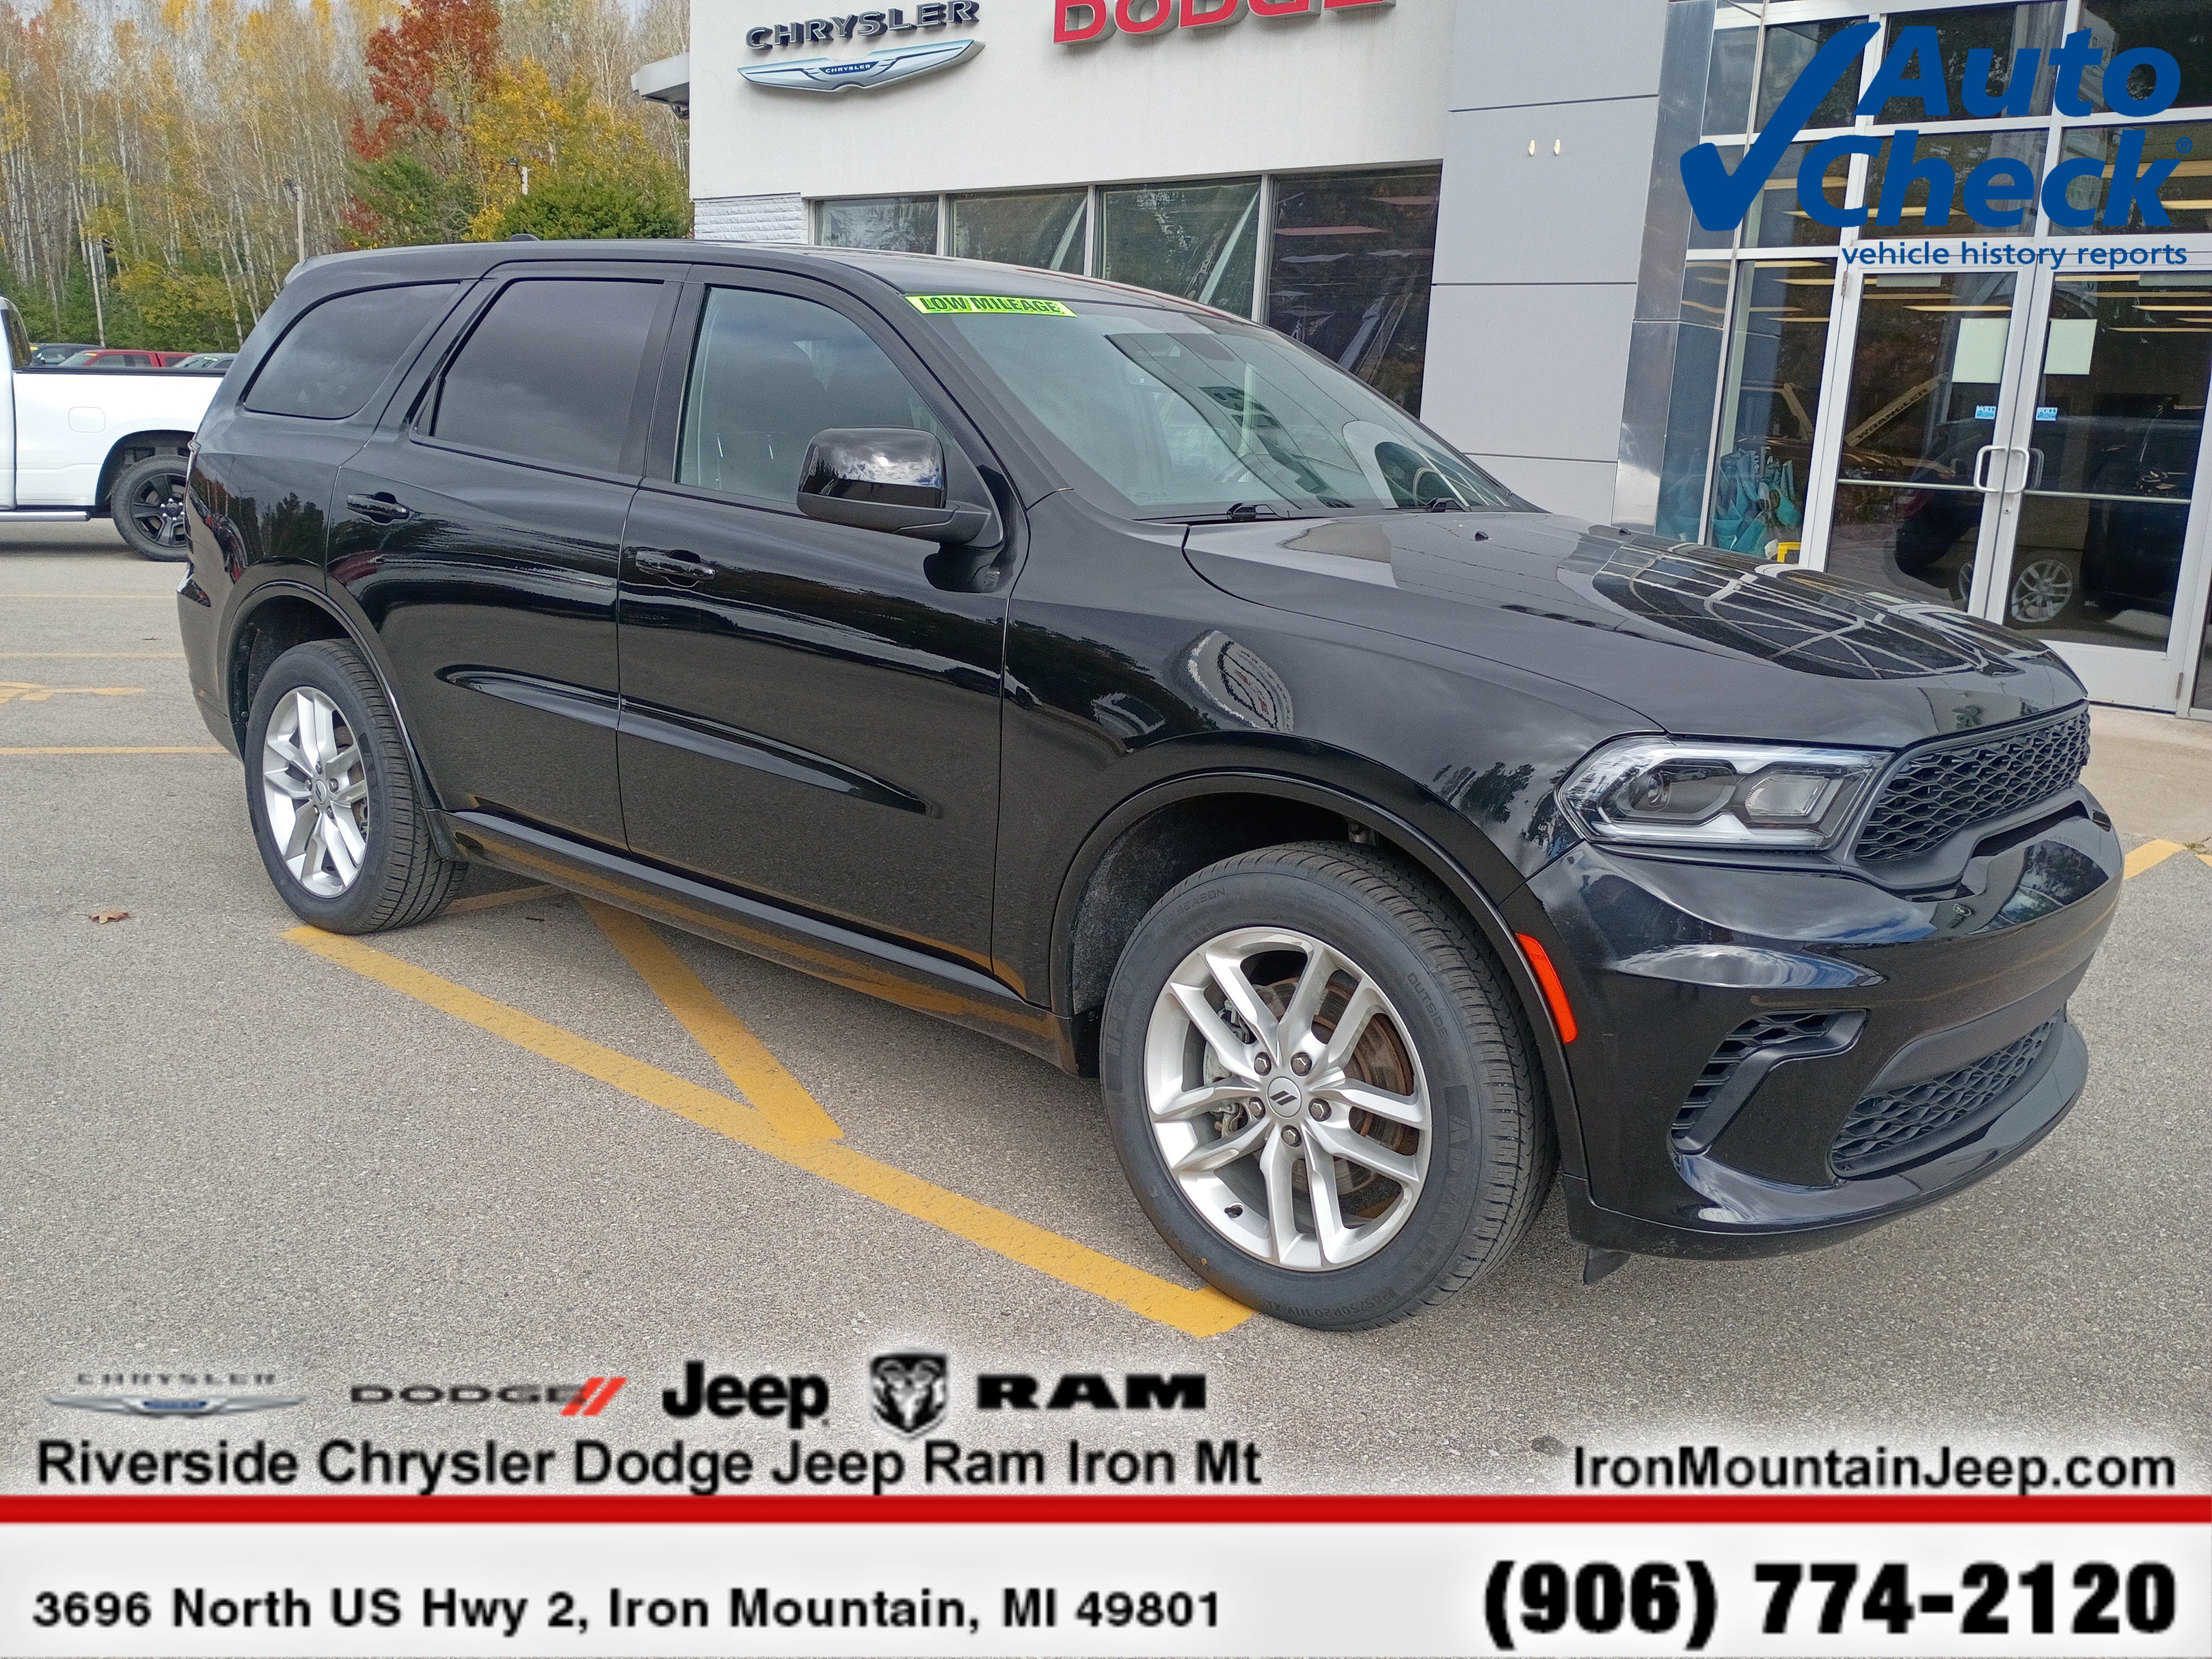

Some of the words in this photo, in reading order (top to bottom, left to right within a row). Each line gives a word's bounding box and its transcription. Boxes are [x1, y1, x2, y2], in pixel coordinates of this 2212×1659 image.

[745, 0, 978, 49] CHRYSLER
[1054, 0, 1391, 44] DOD
[825, 64, 871, 73] CHRYSLER
[919, 298, 968, 311] LOW
[970, 298, 1062, 313] MILEAGE
[1175, 886, 1226, 918] SEASON
[1406, 972, 1449, 1038] OUTSIDE
